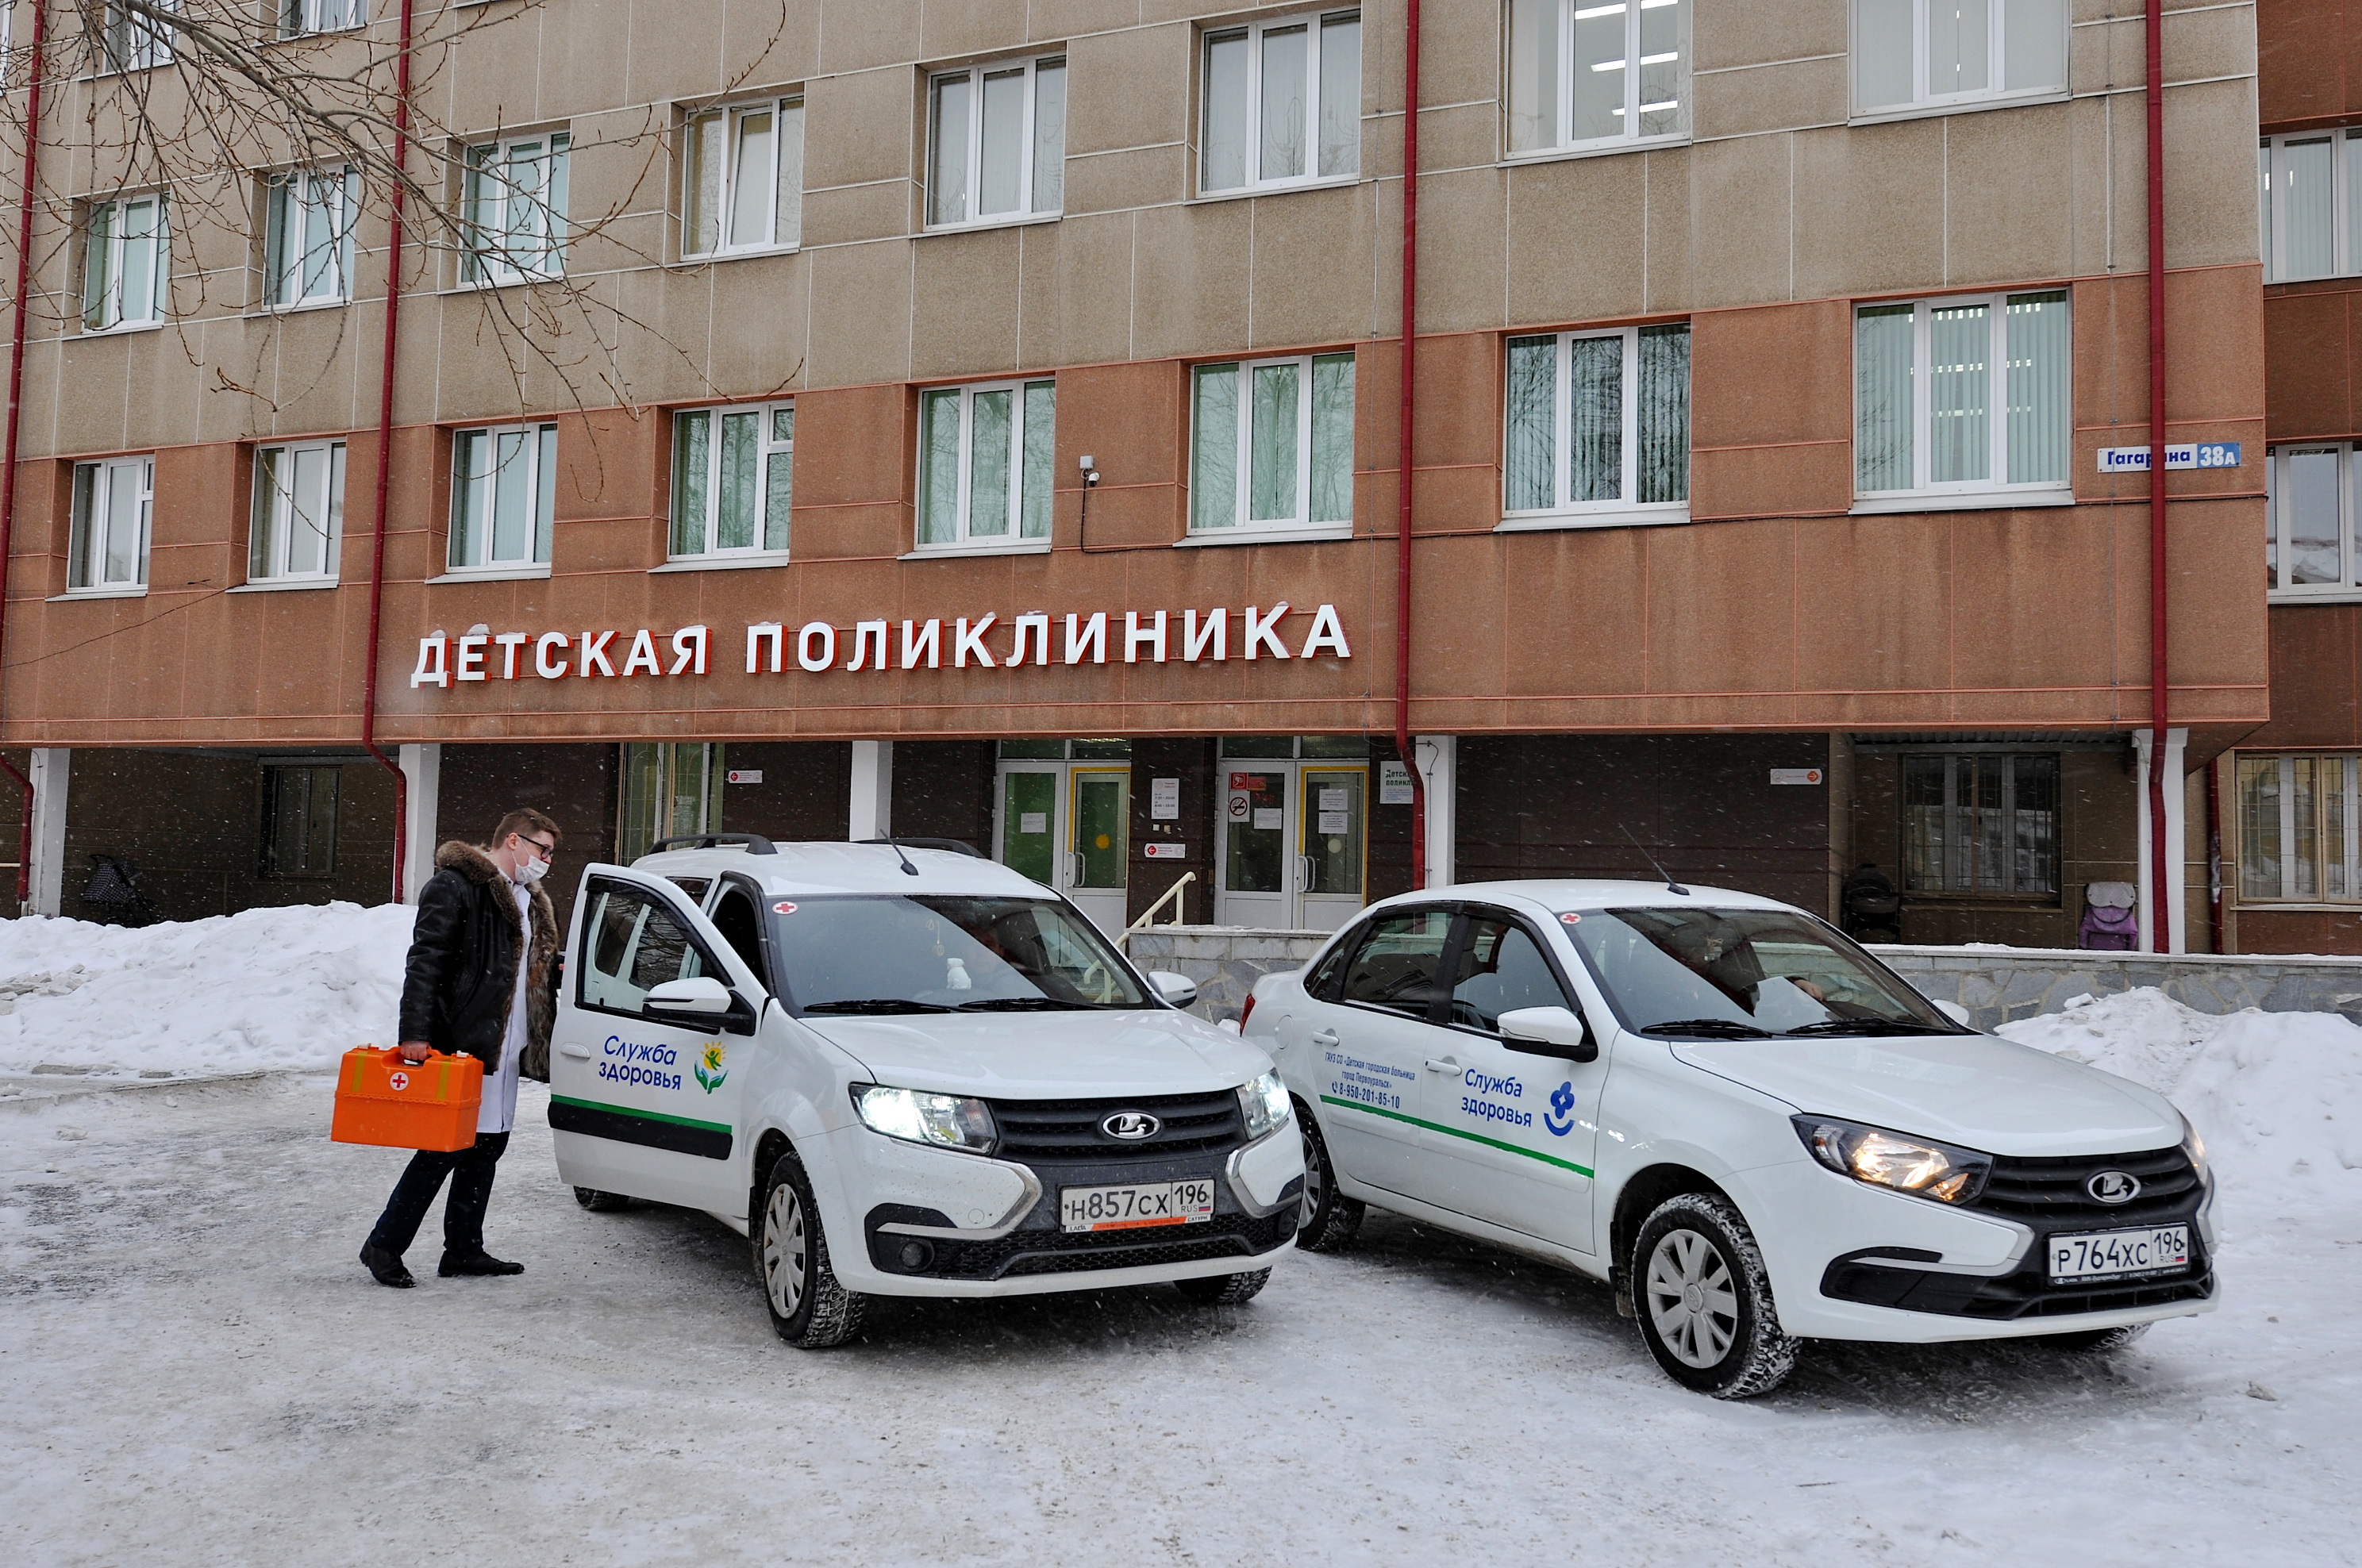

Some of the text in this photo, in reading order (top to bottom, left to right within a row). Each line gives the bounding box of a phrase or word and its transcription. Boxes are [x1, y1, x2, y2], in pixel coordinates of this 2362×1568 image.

[2107, 445, 2237, 468] Гагарна 38А
[410, 604, 1351, 689] ДЕТСКАЯ ПОЛИКЛИНИКА
[1386, 769, 1410, 778] Детск
[604, 1035, 677, 1066] Служба
[598, 1062, 681, 1090] здоровья
[1325, 1051, 1336, 1063] ГАУЗ
[1336, 1055, 1344, 1065] СО
[1365, 1062, 1391, 1075] городская
[1391, 1066, 1416, 1081] больница
[1341, 1070, 1355, 1082] город
[1339, 1082, 1401, 1109] 8-950-201-85-10
[1465, 1068, 1523, 1097] Служба
[1461, 1097, 1532, 1128] здоровья
[1174, 1183, 1207, 1205] 196
[1180, 1204, 1198, 1213] RUS
[2153, 1230, 2183, 1255] 196
[2160, 1254, 2175, 1263] RUS
